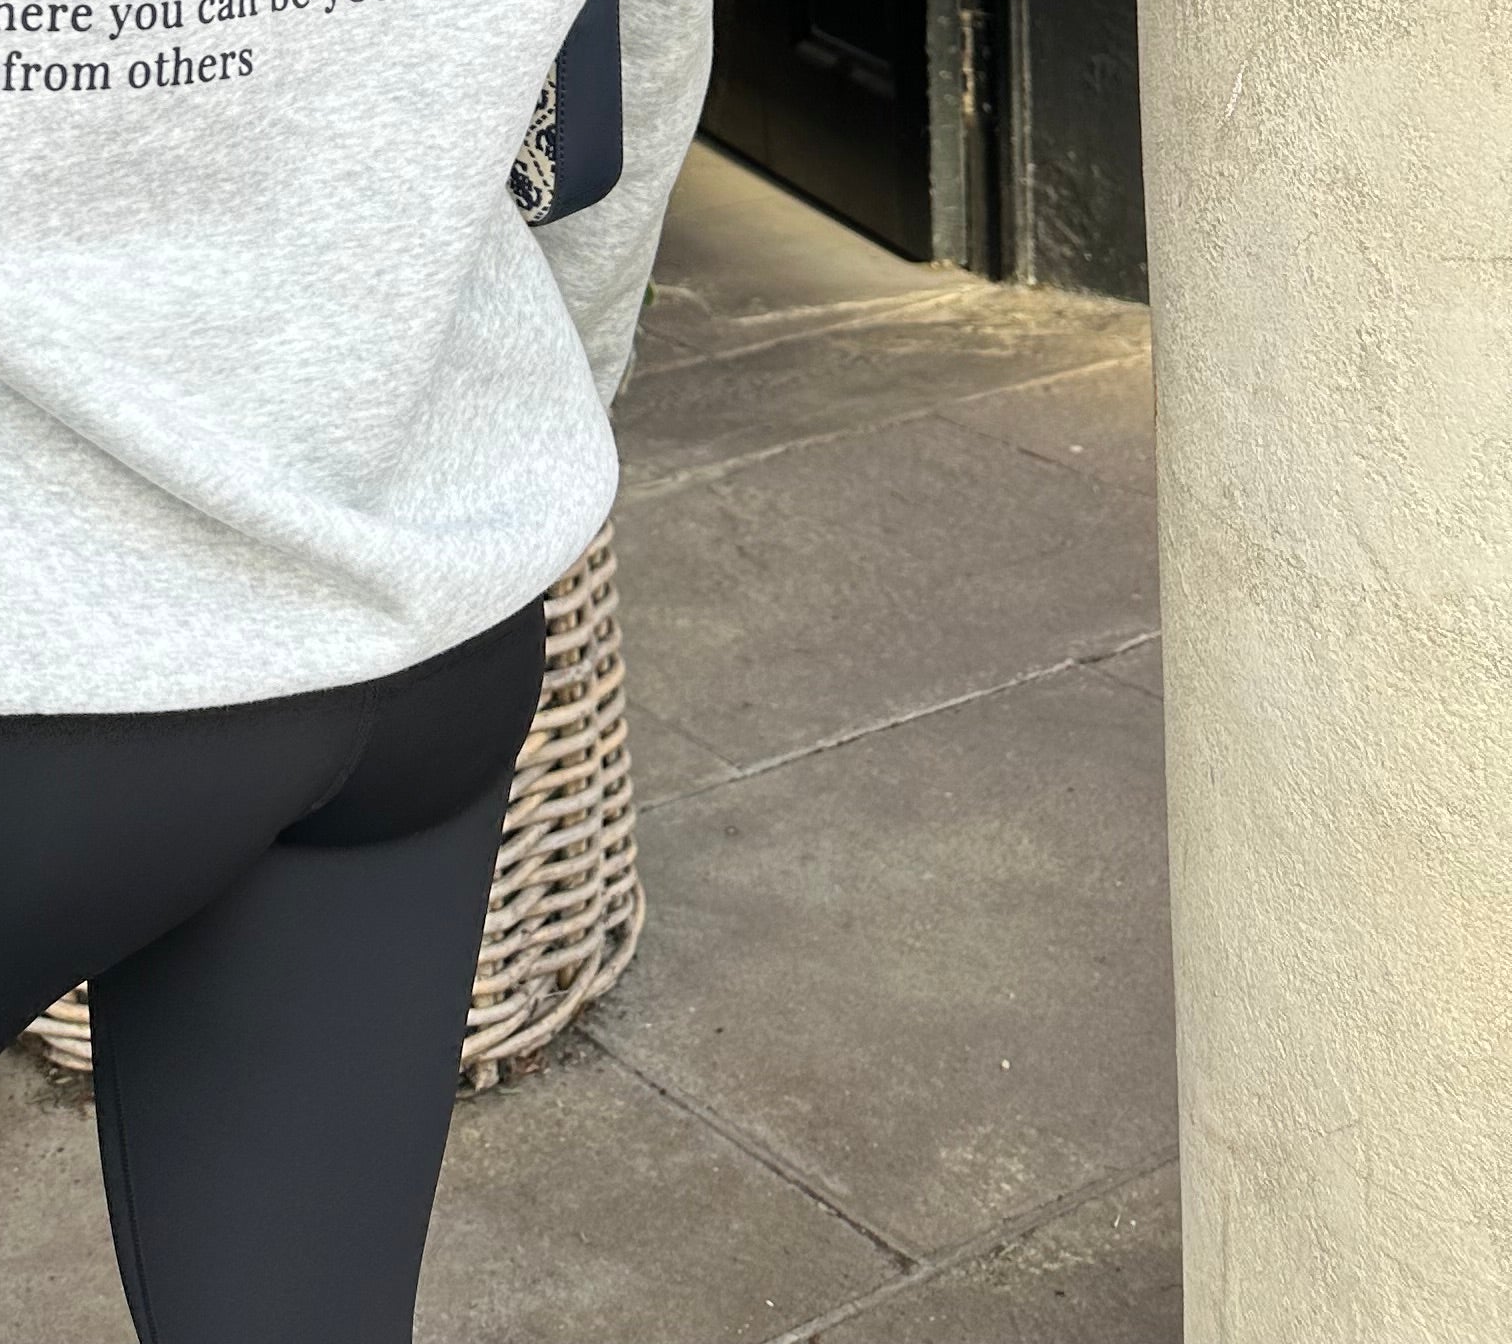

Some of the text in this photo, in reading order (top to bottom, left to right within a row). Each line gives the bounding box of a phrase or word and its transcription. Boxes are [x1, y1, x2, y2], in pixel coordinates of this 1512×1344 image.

[108, 0, 185, 41] you
[1, 50, 112, 92] from
[127, 42, 254, 90] others
